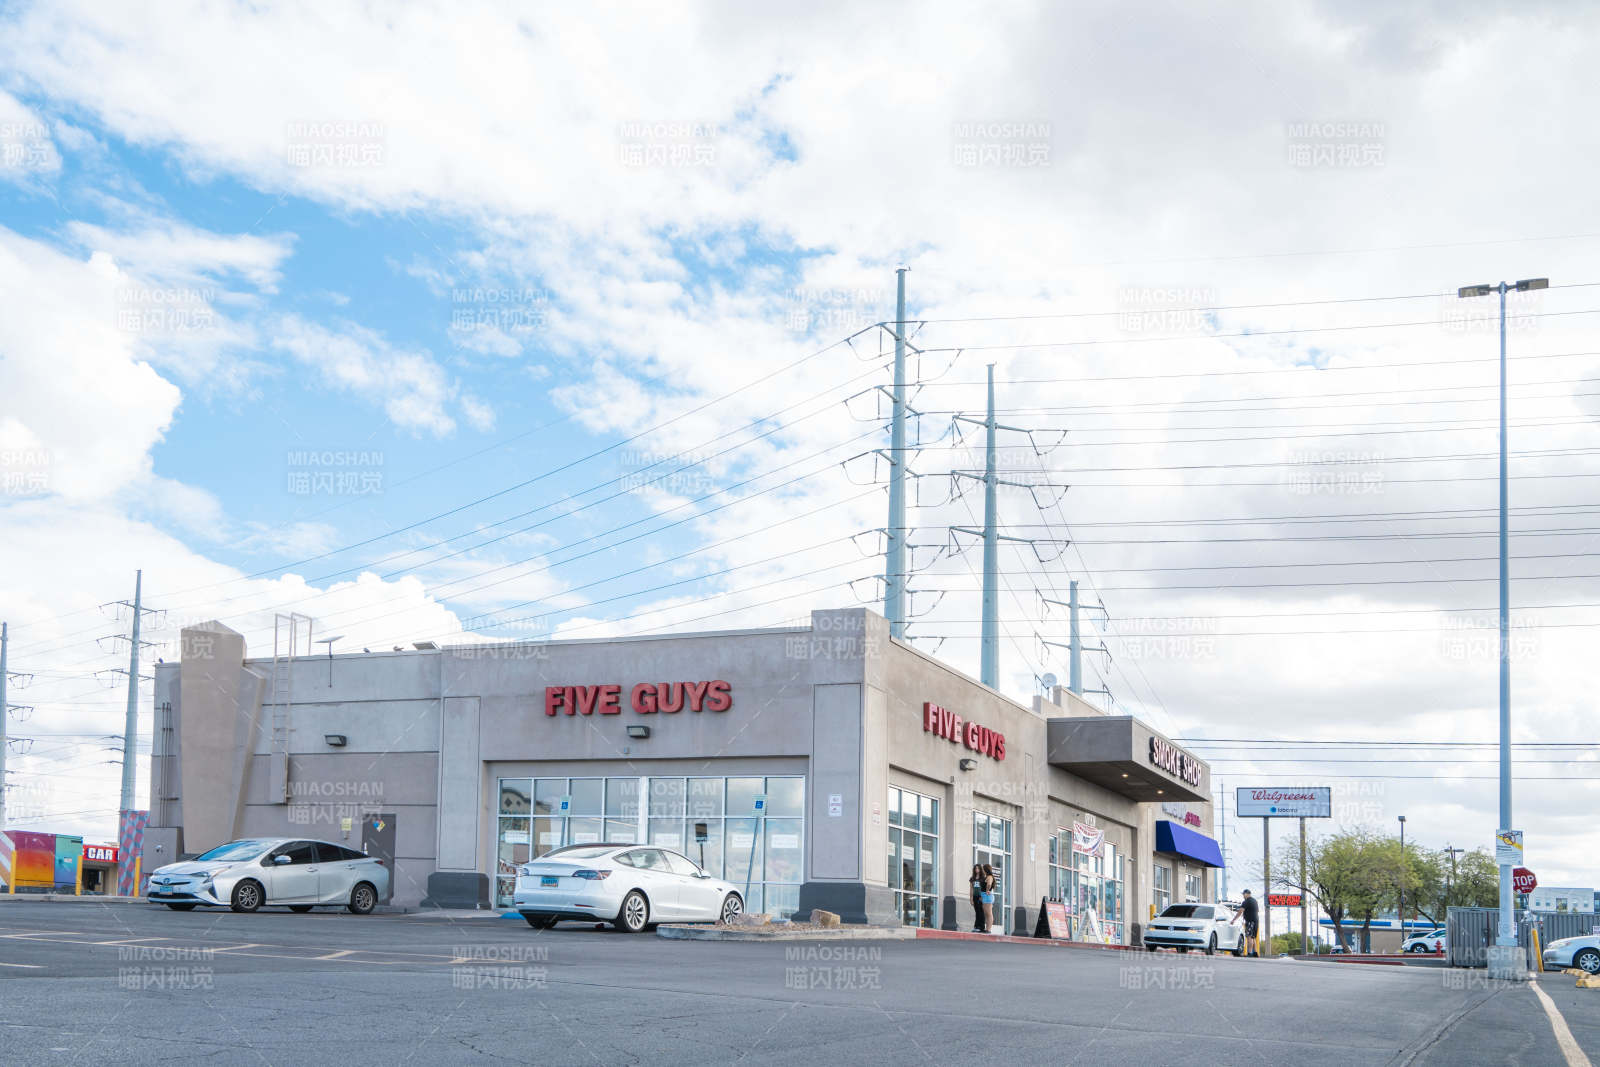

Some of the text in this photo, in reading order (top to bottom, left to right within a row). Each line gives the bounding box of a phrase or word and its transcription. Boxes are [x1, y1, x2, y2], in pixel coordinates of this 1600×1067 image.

[545, 680, 732, 717] FIVE GUYS
[923, 702, 1006, 761] FIVE GUYS
[1150, 736, 1202, 787] SMOKE SHOP
[1251, 789, 1316, 804] Walgreens
[87, 847, 113, 860] CAR
[1513, 874, 1534, 887] TOP
